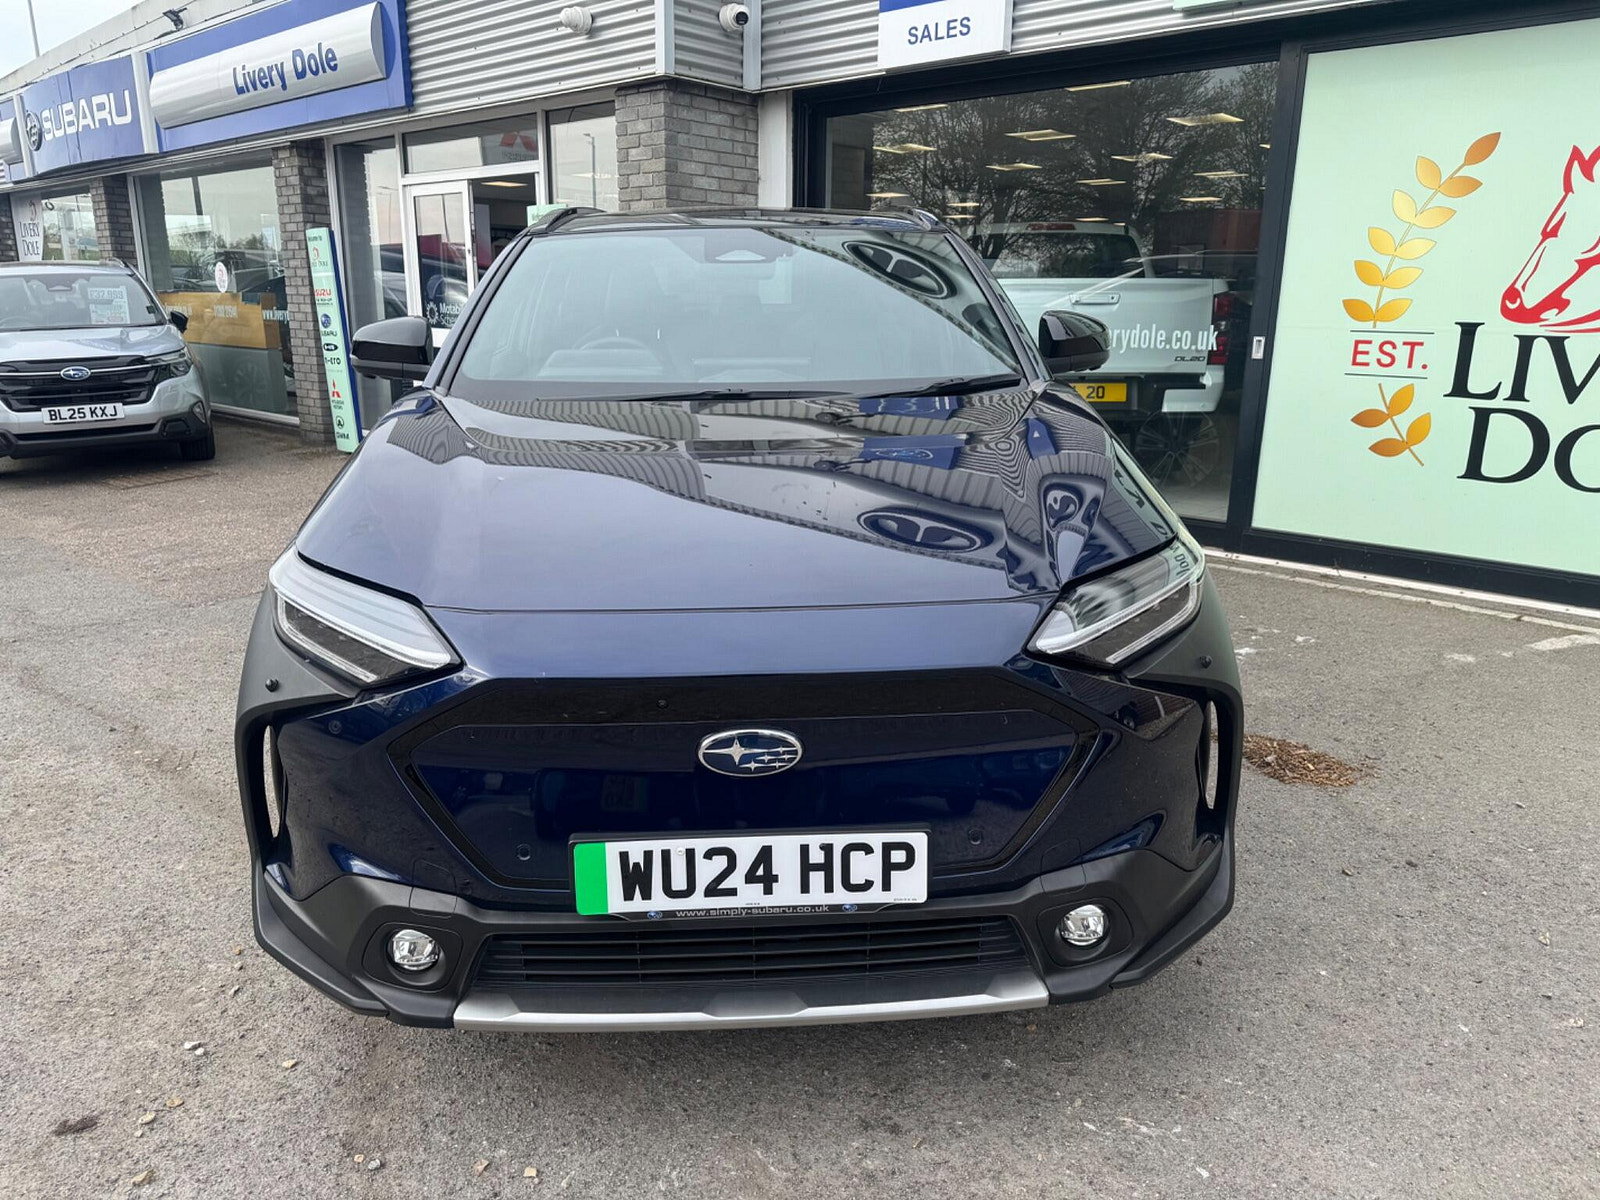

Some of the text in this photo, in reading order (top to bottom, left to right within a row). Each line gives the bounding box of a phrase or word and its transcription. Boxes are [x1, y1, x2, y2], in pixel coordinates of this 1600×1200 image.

[908, 16, 971, 45] SALES
[232, 42, 338, 96] Livery Dole
[40, 90, 132, 142] SUBARU
[1351, 339, 1428, 370] EST.
[1086, 386, 1105, 399] 20
[48, 404, 118, 422] BL25 KXJ
[619, 841, 916, 902] WU24 HCP
[675, 903, 830, 918] www.simply-subaru.co.uk
